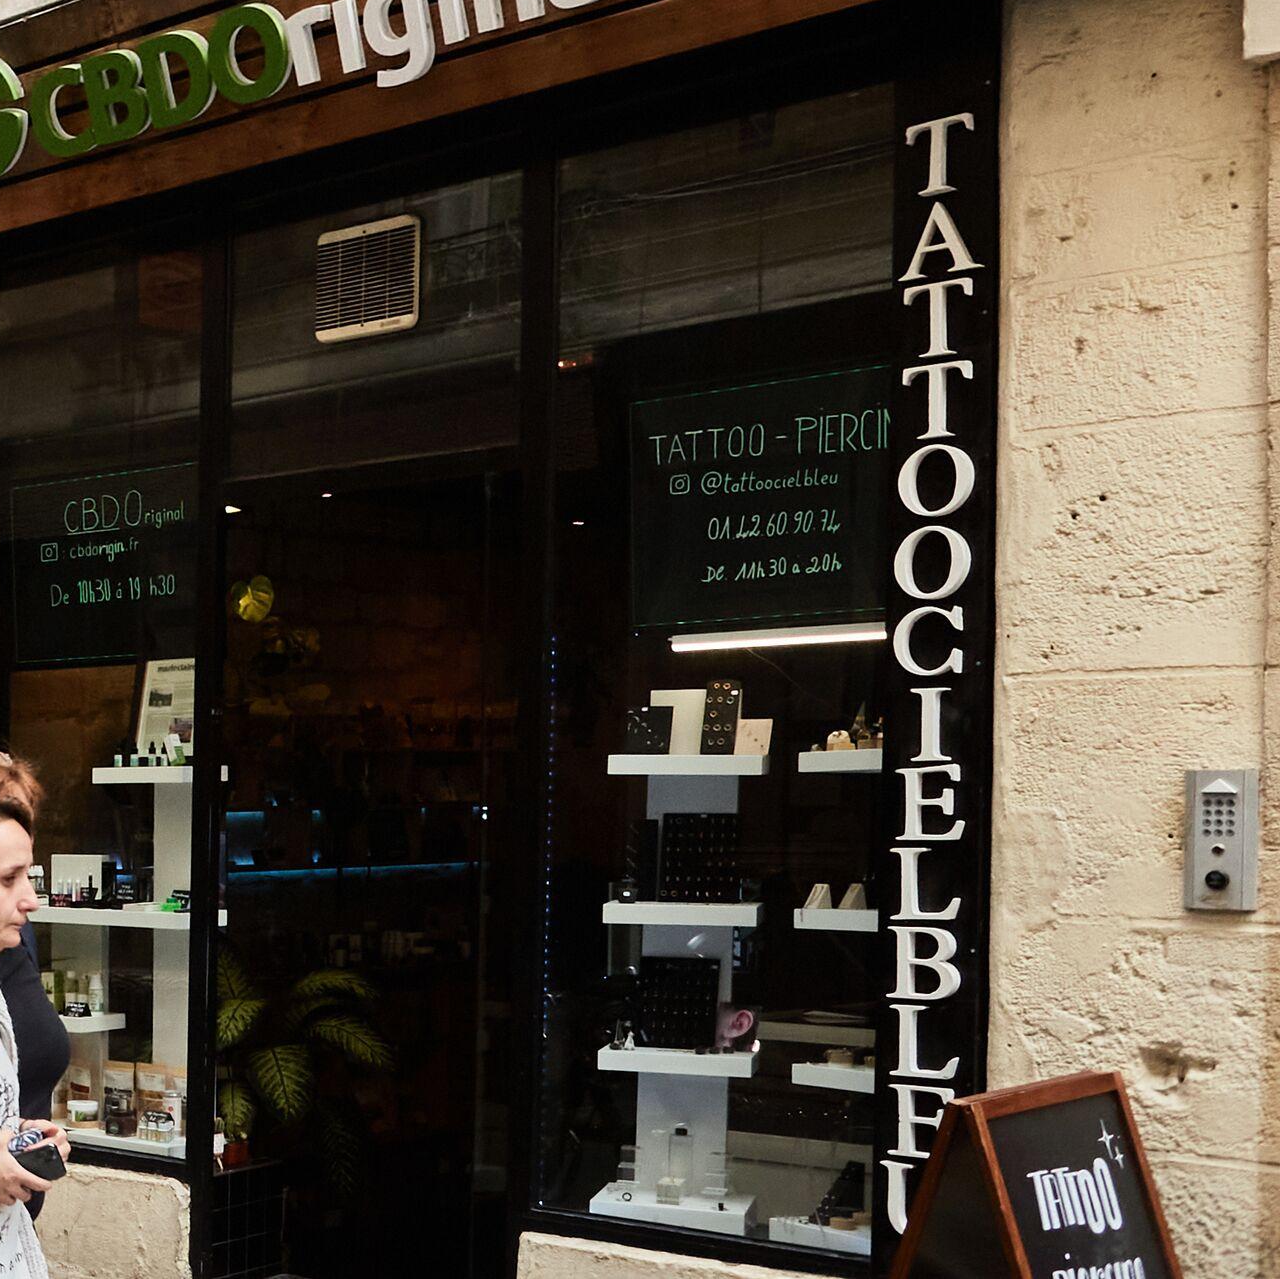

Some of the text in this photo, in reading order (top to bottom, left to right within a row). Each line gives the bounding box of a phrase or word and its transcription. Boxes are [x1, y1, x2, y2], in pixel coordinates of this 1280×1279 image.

[648, 423, 765, 466] TATTOO
[806, 552, 842, 574] 20h
[51, 584, 69, 607] De
[77, 578, 111, 604] 10h30
[1027, 1157, 1123, 1234] TATTOO
